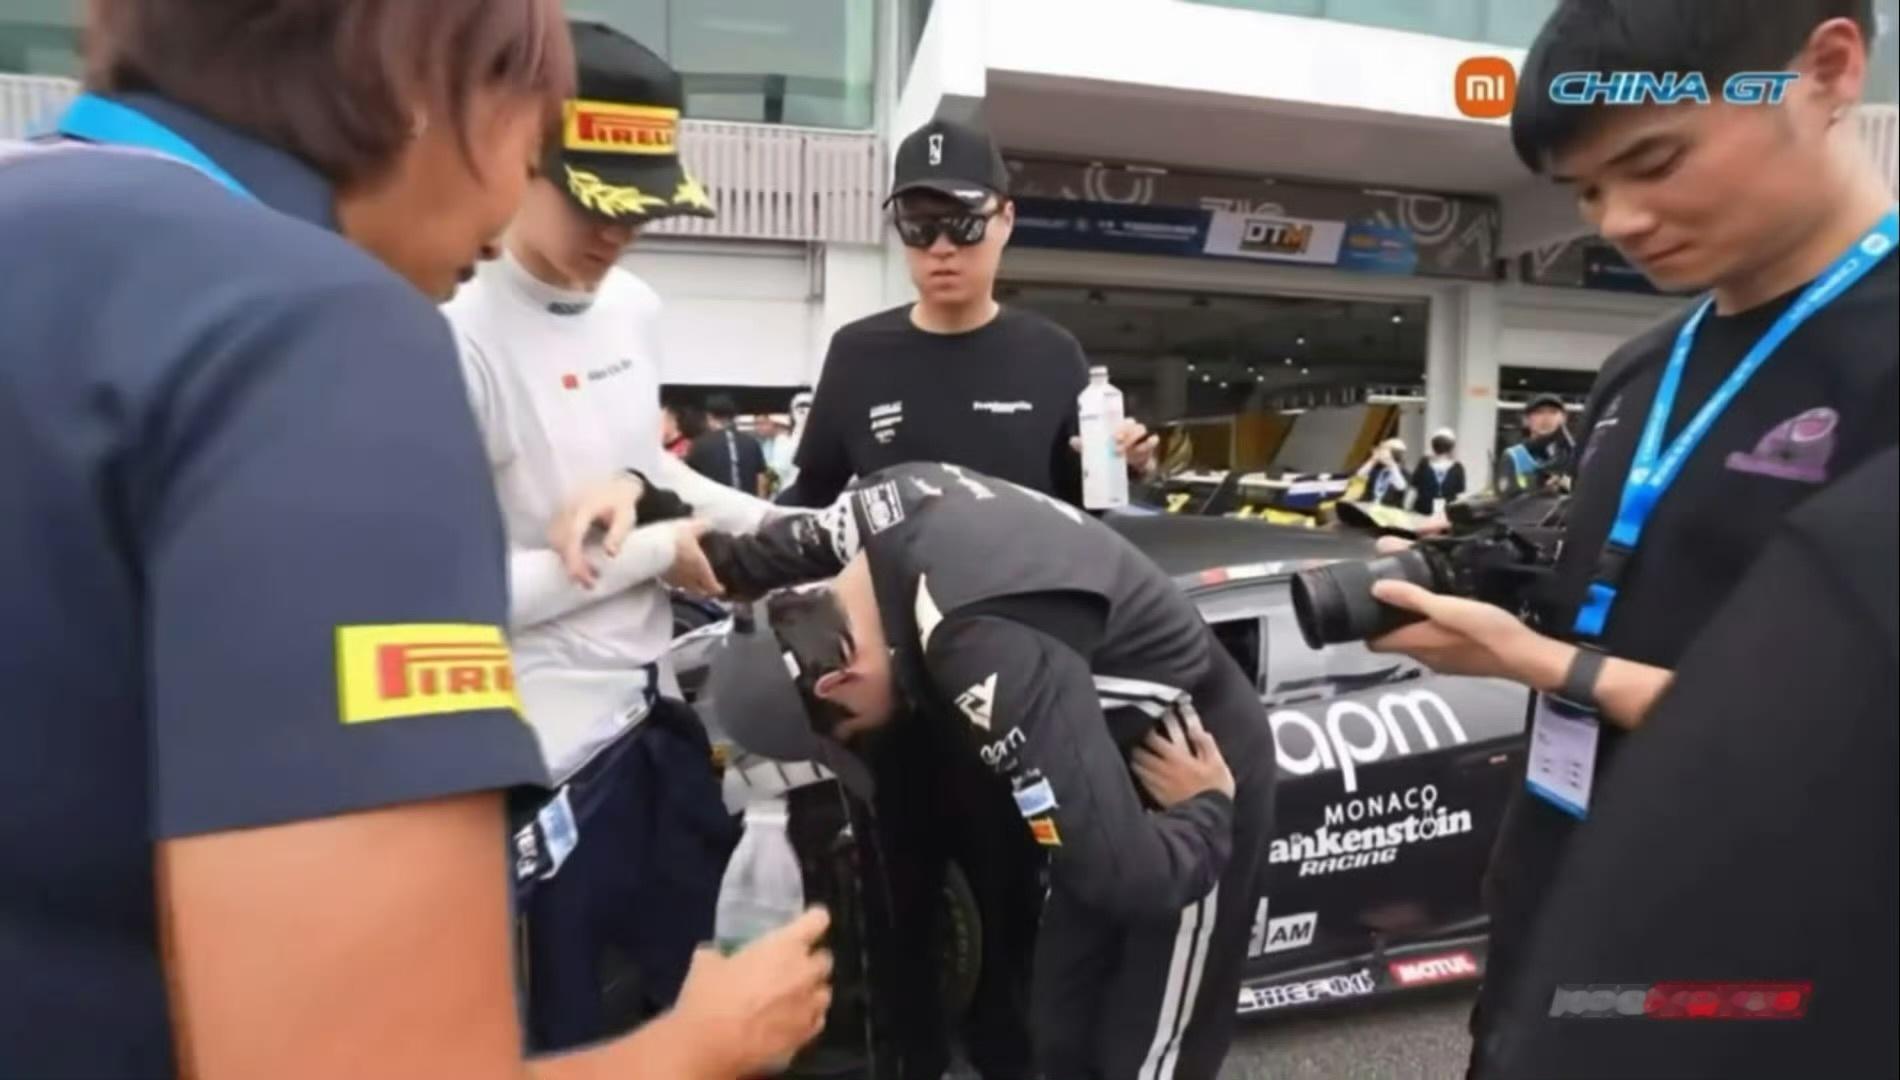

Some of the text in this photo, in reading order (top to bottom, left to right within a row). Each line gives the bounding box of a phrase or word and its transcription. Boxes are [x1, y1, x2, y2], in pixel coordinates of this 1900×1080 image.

[1325, 784, 1438, 826] MONACO
[1299, 848, 1398, 877] RACING
[1271, 922, 1312, 945] AM
